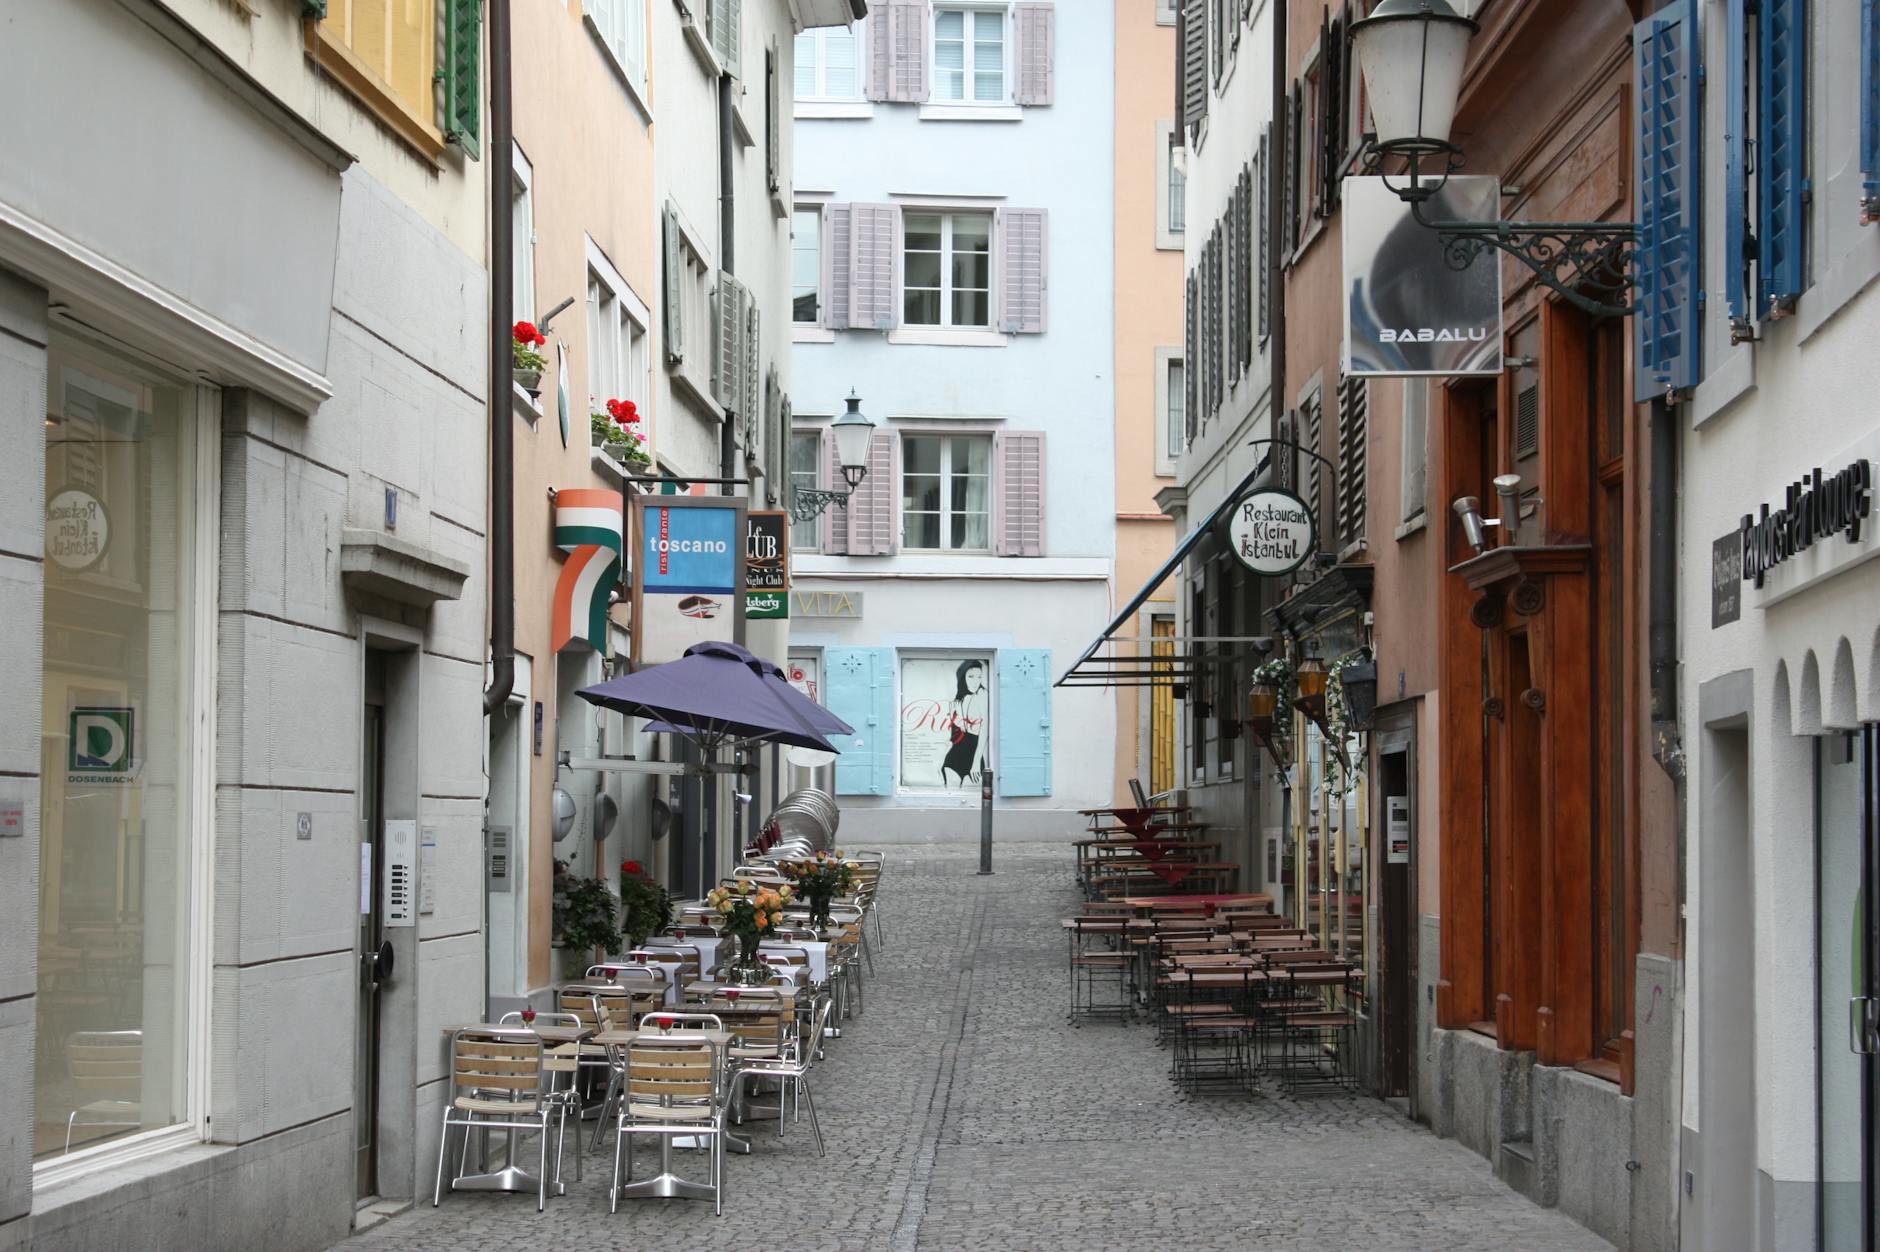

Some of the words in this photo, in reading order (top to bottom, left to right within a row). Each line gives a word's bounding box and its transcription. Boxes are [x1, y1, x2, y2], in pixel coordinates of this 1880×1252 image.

[1380, 328, 1485, 342] BABALU
[1243, 503, 1307, 525] Restaurant
[748, 519, 763, 537] Le
[1253, 522, 1289, 541] Klein
[650, 536, 726, 553] toscano
[765, 574, 783, 585] Club
[797, 591, 854, 615] VITA
[68, 775, 135, 784] DOSENBACH
